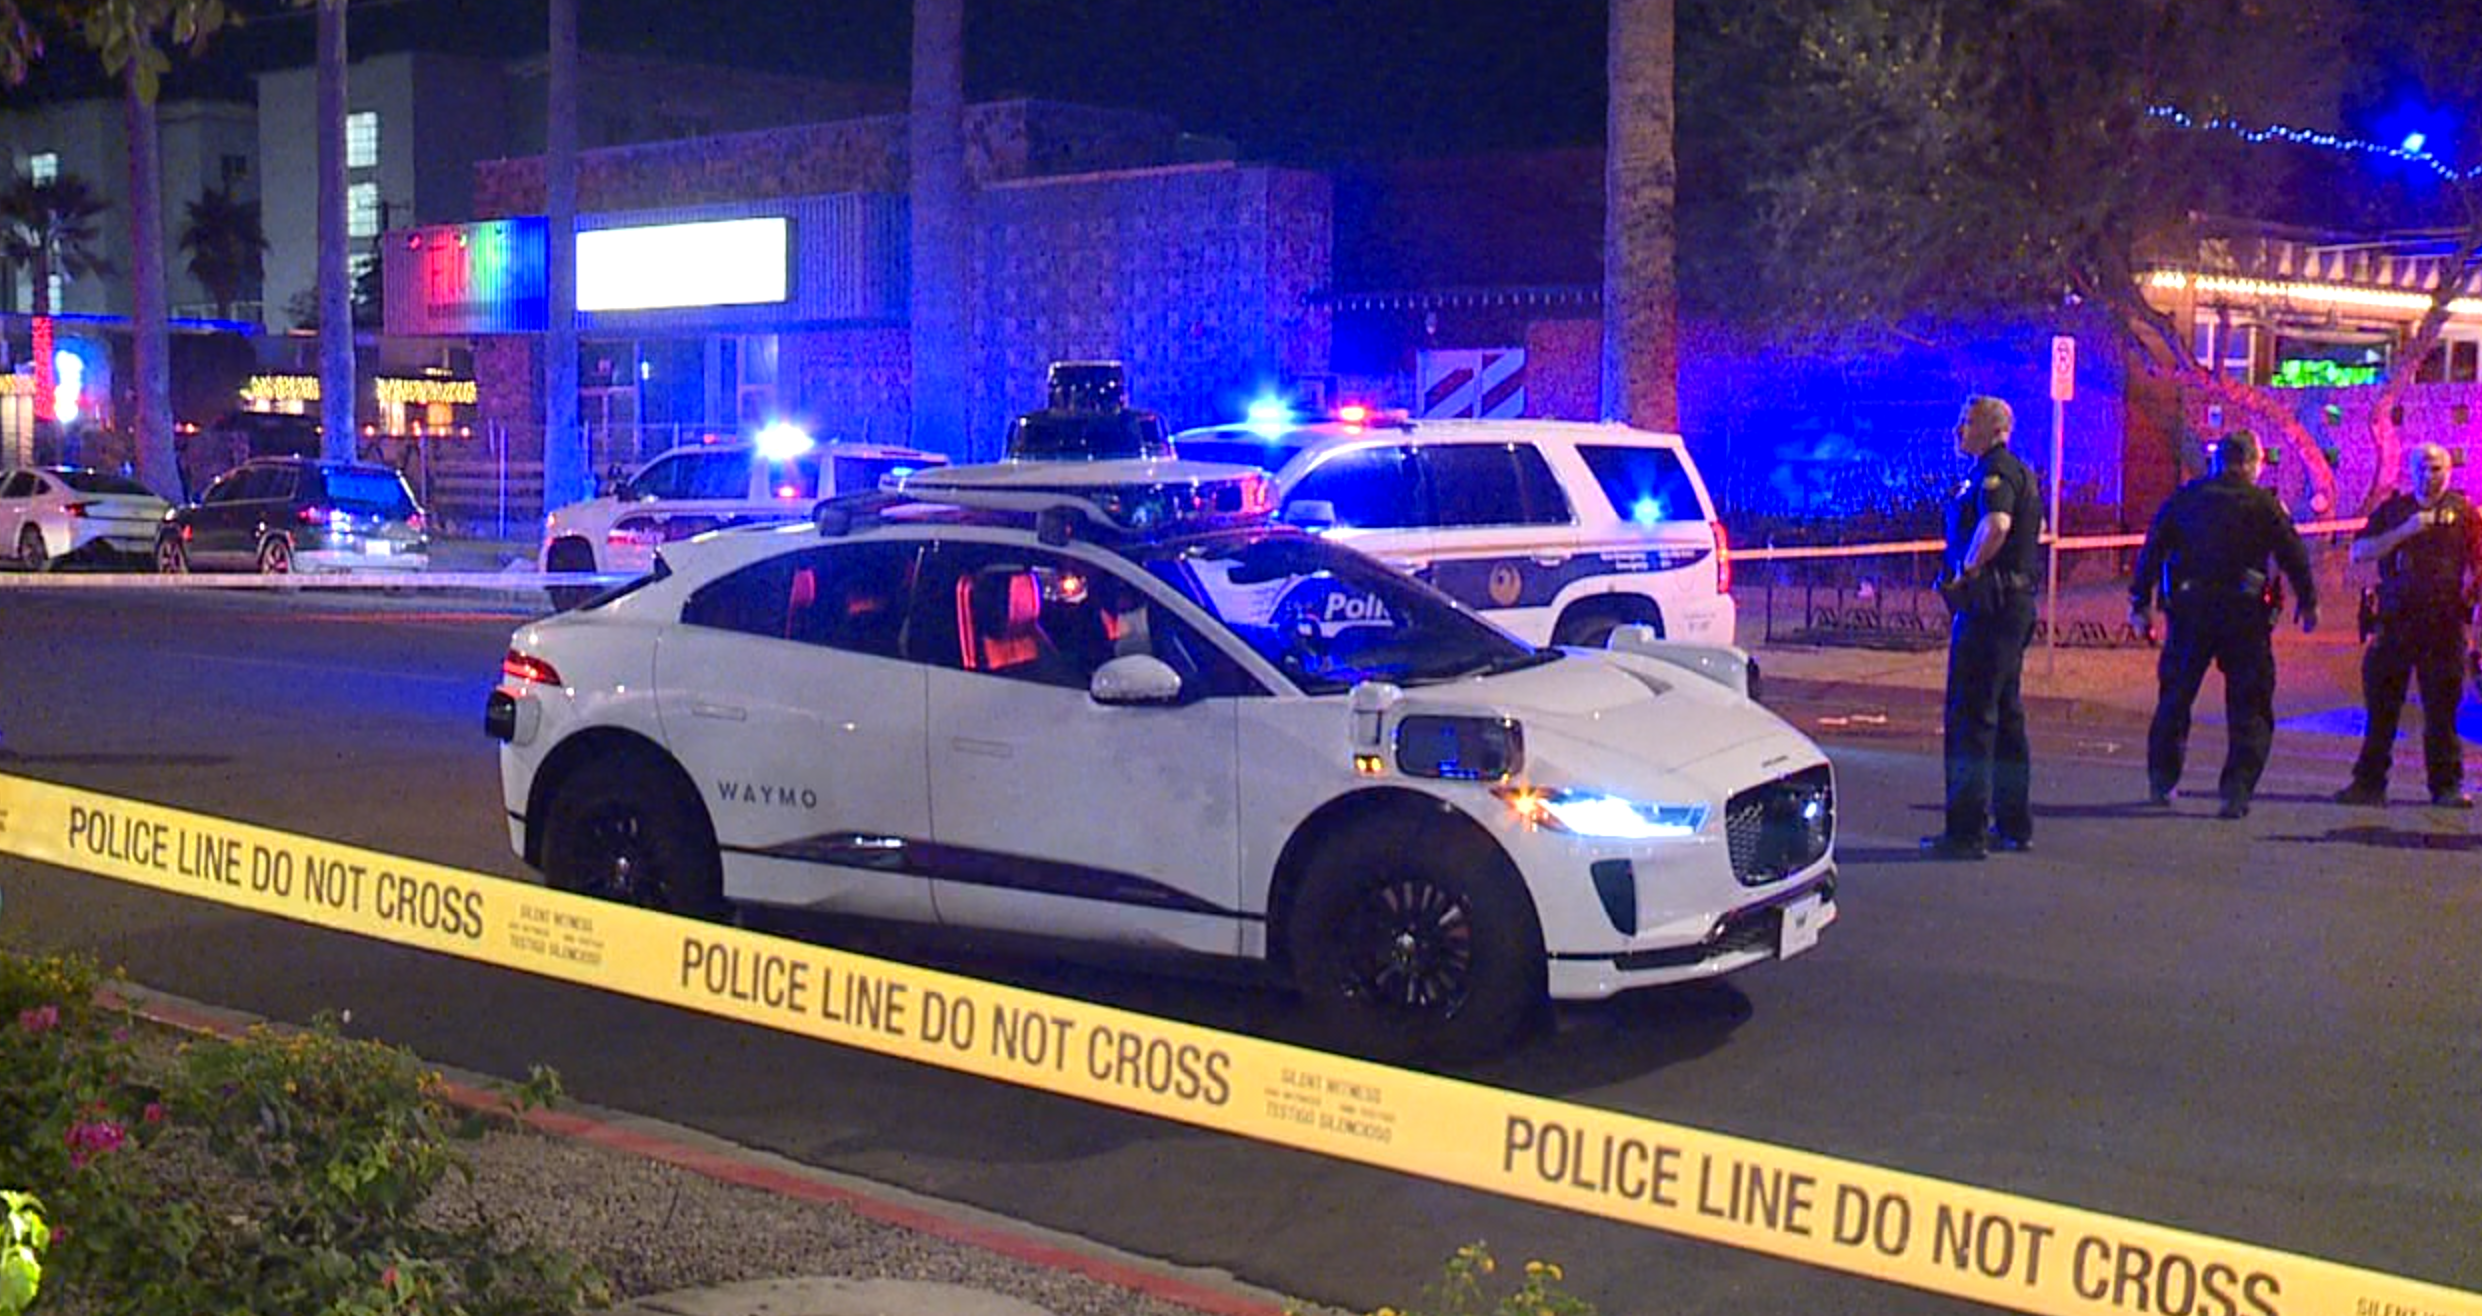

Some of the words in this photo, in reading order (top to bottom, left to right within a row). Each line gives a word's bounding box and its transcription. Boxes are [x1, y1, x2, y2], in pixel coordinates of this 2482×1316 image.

[1324, 592, 1391, 620] Poli
[718, 780, 817, 809] WAYMO
[69, 806, 169, 869] POLICE
[178, 830, 242, 886] LINE
[252, 845, 293, 897] DO
[304, 855, 366, 912] NOT
[376, 871, 484, 939] CROSS
[682, 937, 809, 1014] POLICE
[821, 967, 907, 1036] LINE
[920, 990, 975, 1051] DO
[991, 1002, 1075, 1071] NOT
[1087, 1024, 1231, 1106] CROSS
[1504, 1114, 1681, 1208] POLICE
[1697, 1153, 1816, 1237] LINE
[1832, 1183, 1911, 1257] DO
[1933, 1203, 2054, 1287] NOT
[2072, 1235, 2282, 1316] CROSS
